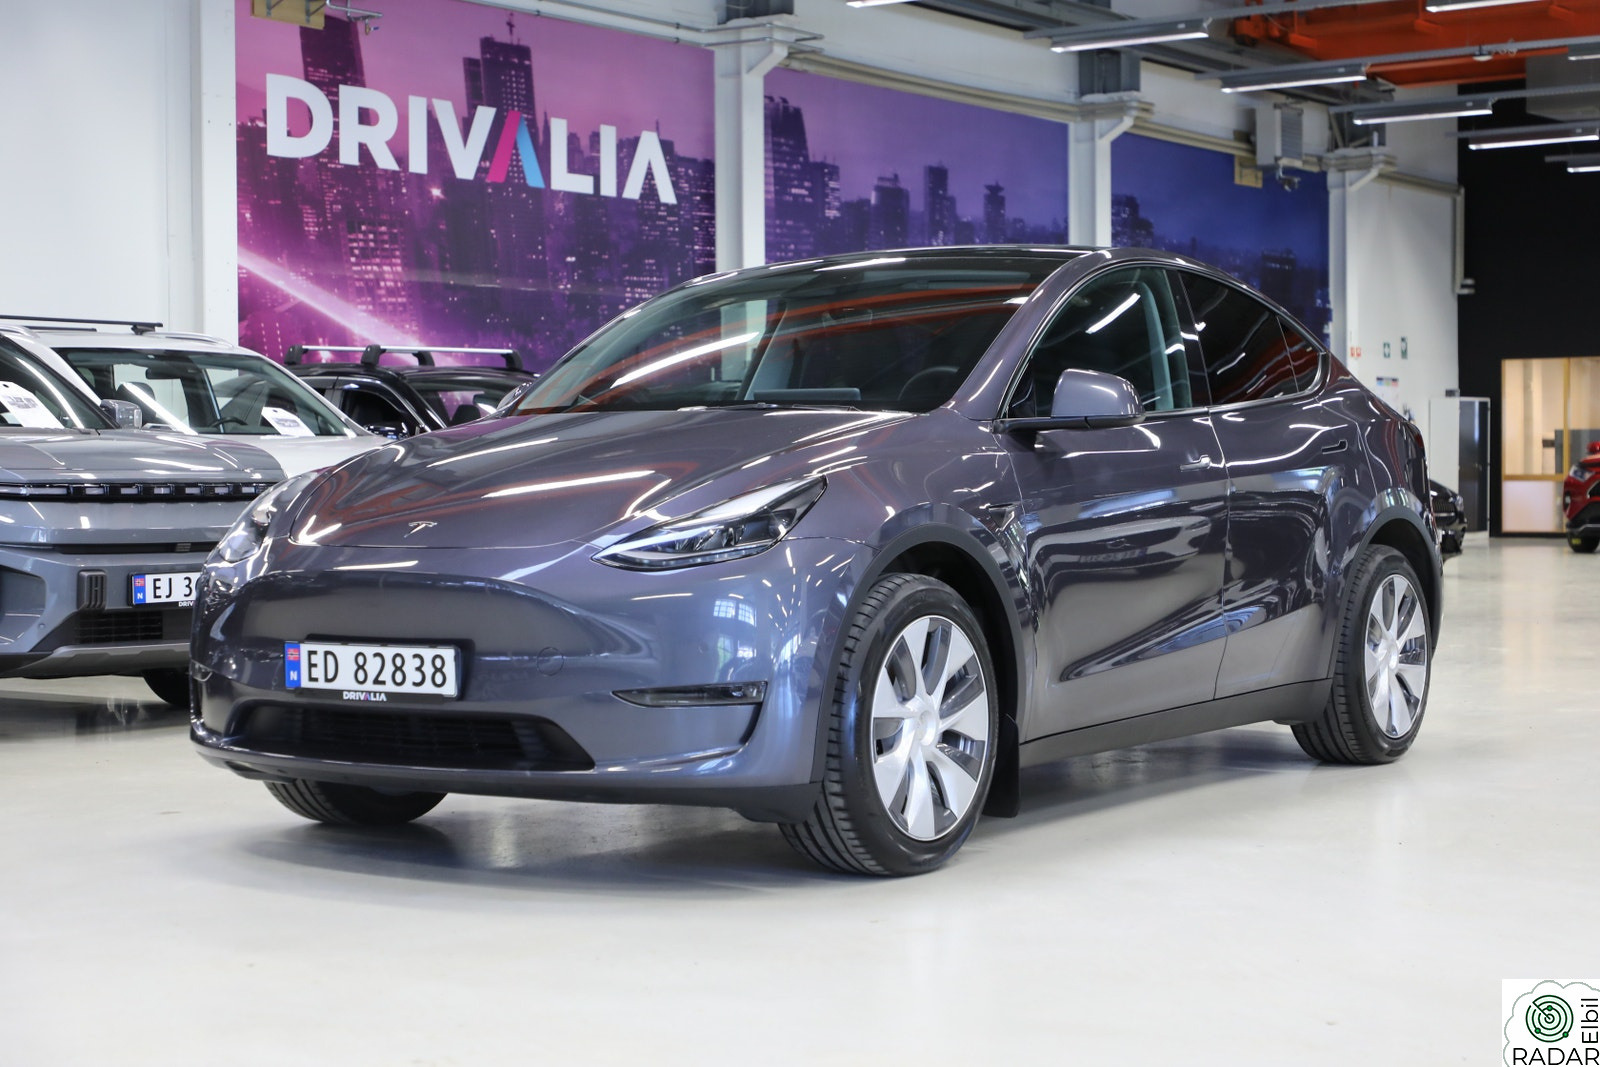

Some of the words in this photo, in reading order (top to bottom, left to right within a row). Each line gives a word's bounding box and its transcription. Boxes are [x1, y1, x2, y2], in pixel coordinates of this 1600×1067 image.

[265, 73, 678, 205] DRIVALIA
[152, 577, 173, 599] EJ
[289, 670, 298, 681] N
[307, 650, 339, 684] ED
[353, 651, 448, 689] 82838
[342, 690, 388, 702] DRIVALIA
